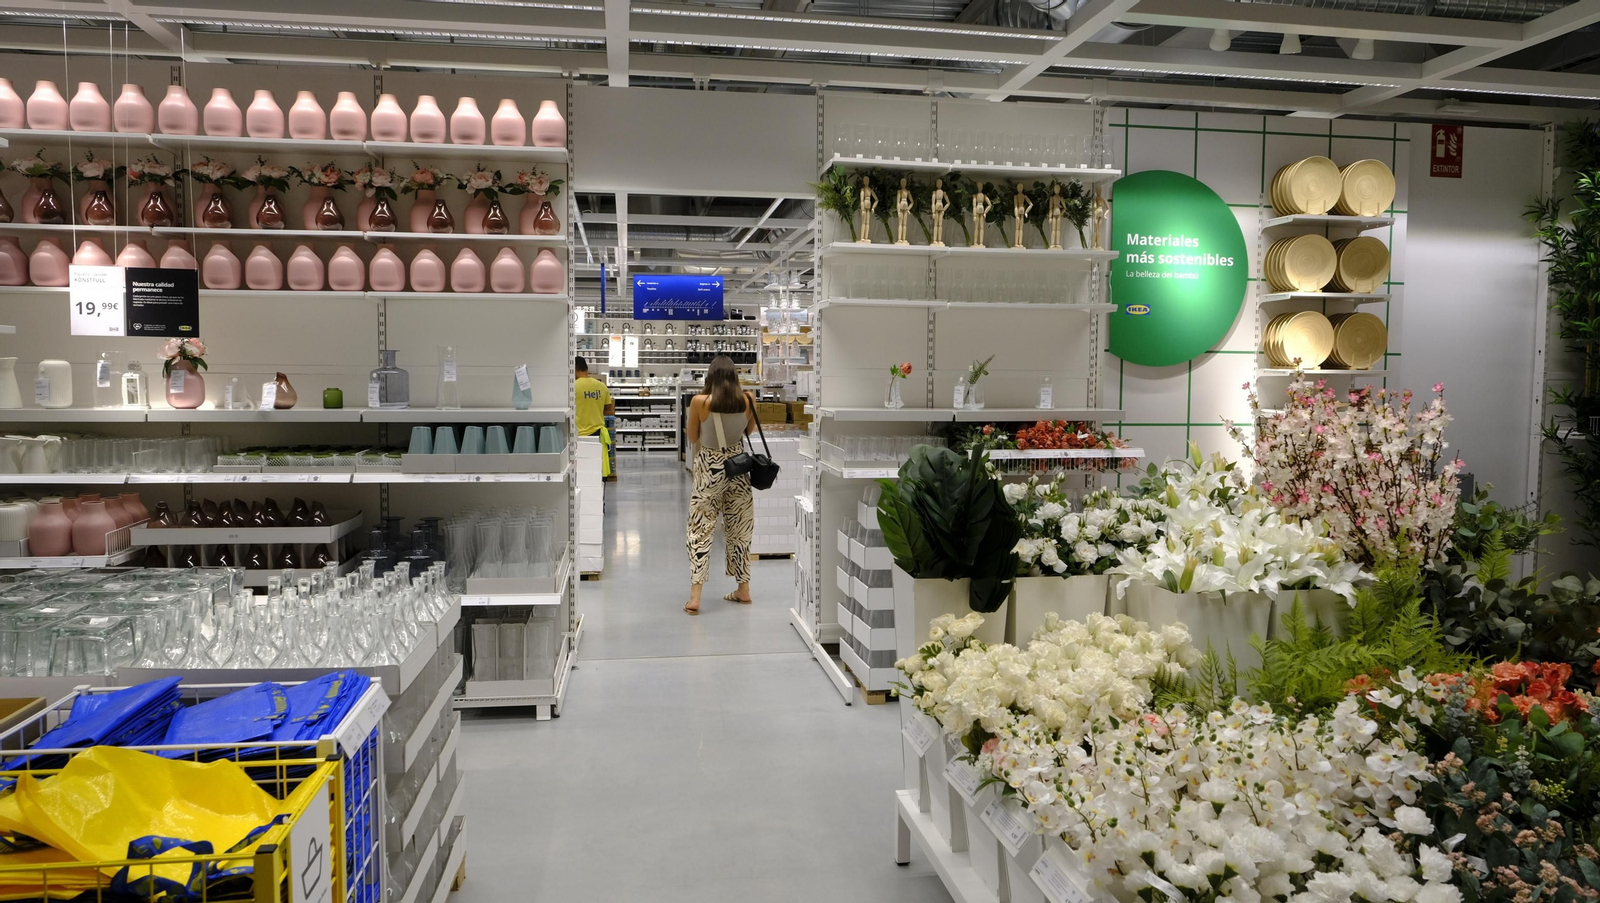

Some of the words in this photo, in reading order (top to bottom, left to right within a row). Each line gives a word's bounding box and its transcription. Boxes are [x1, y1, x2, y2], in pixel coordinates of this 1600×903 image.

[1432, 164, 1460, 174] EXTINTOR
[1127, 233, 1199, 248] Materiales
[1126, 251, 1155, 264] más
[1158, 253, 1234, 267] sostenibles
[1126, 270, 1134, 278] La
[1136, 271, 1160, 279] belleza
[1162, 271, 1172, 279] del
[1174, 271, 1199, 280] bambú
[584, 390, 601, 400] Hej!
